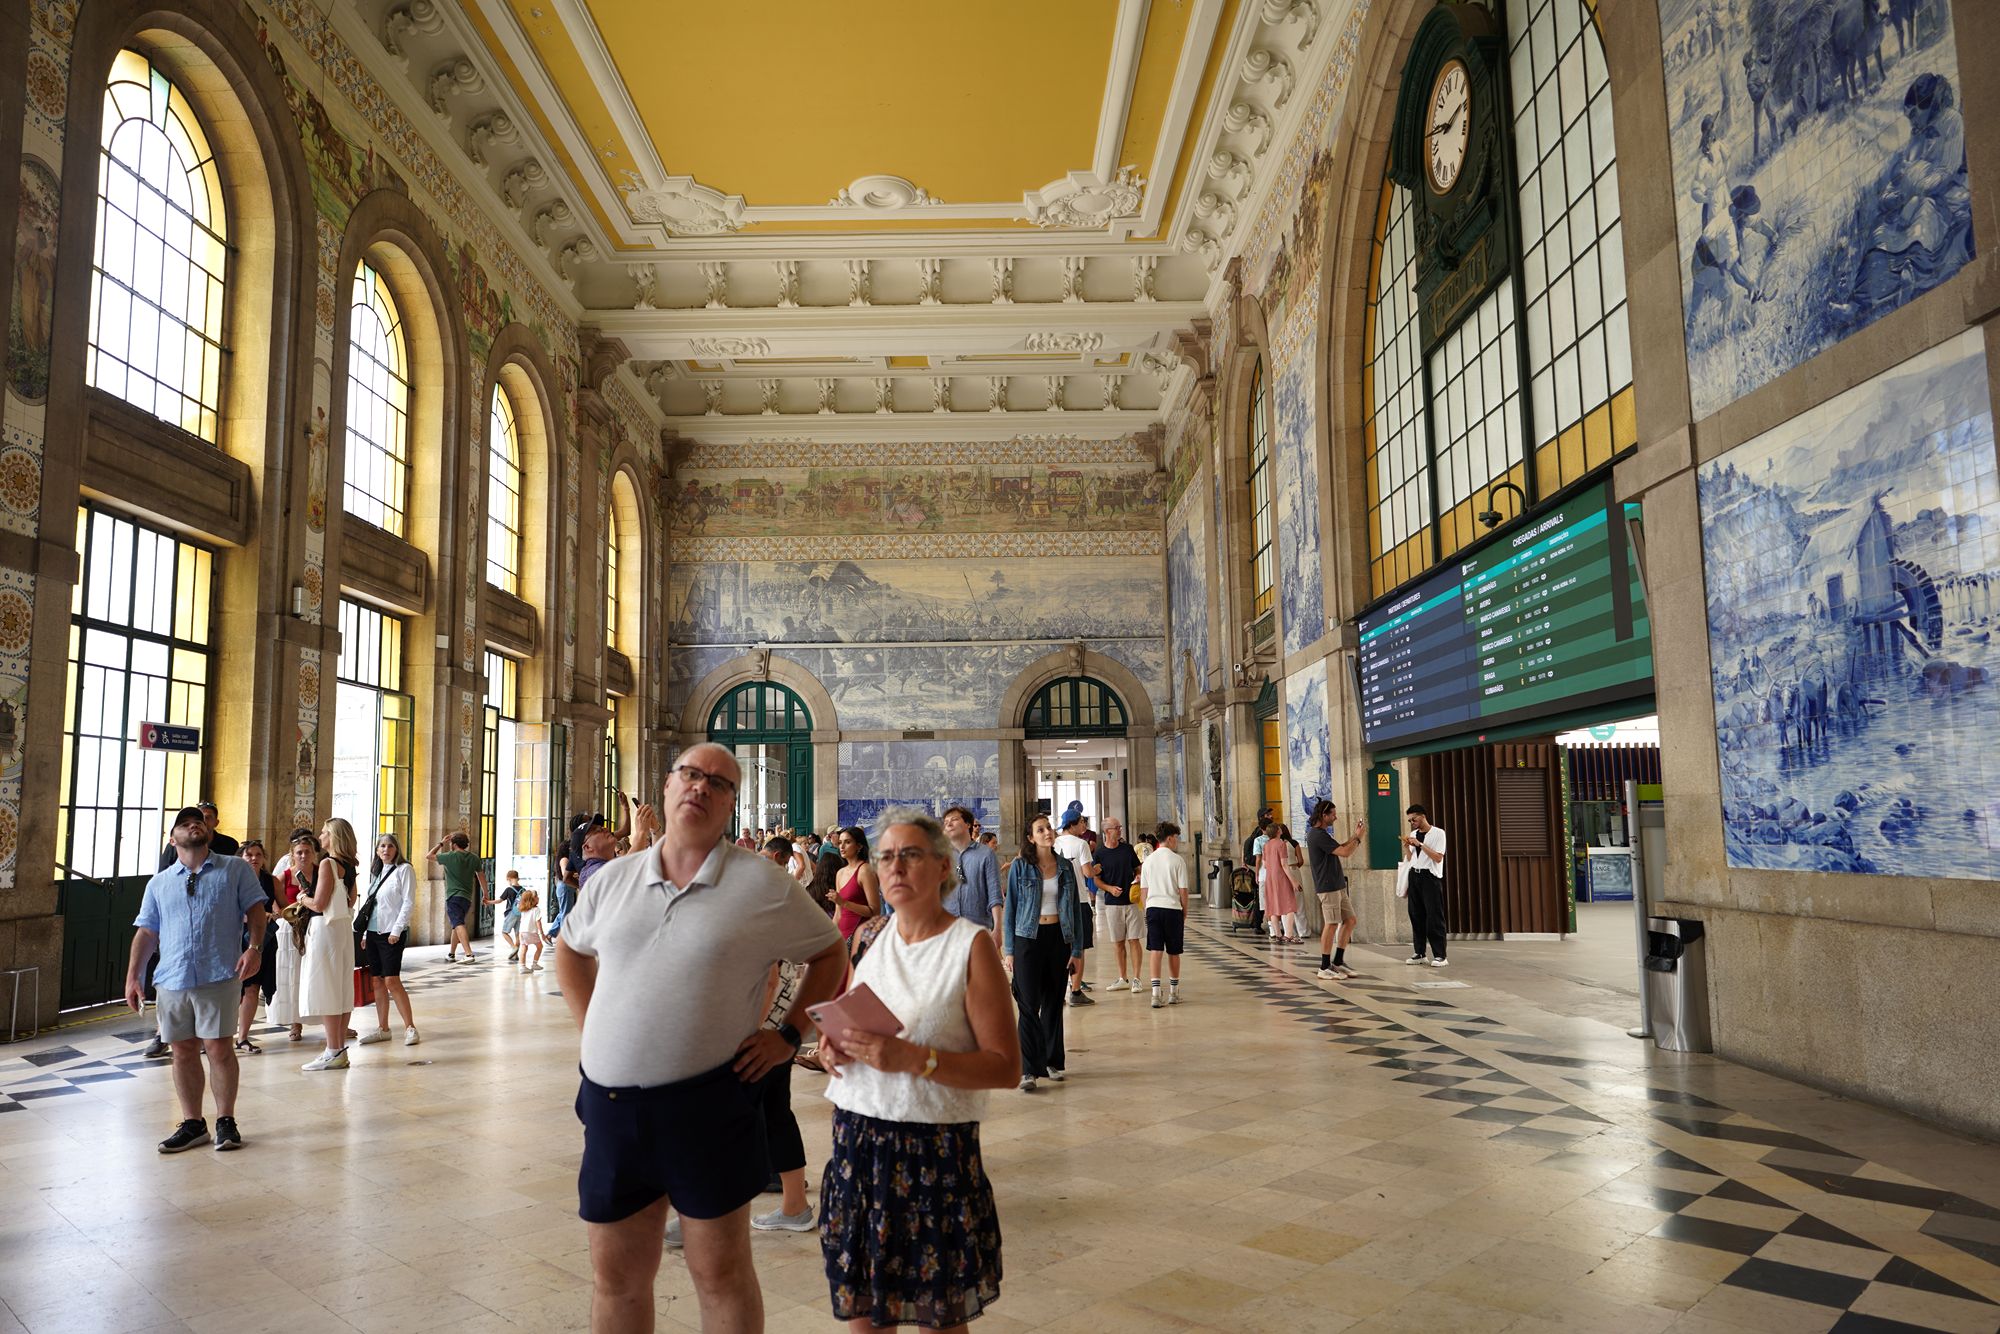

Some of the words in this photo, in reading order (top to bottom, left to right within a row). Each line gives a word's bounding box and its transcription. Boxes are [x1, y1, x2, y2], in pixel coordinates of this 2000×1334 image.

[1513, 527, 1537, 547] CHEGADAS
[1540, 513, 1564, 533] ARRIVALS
[743, 802, 788, 810] JEONYMO
